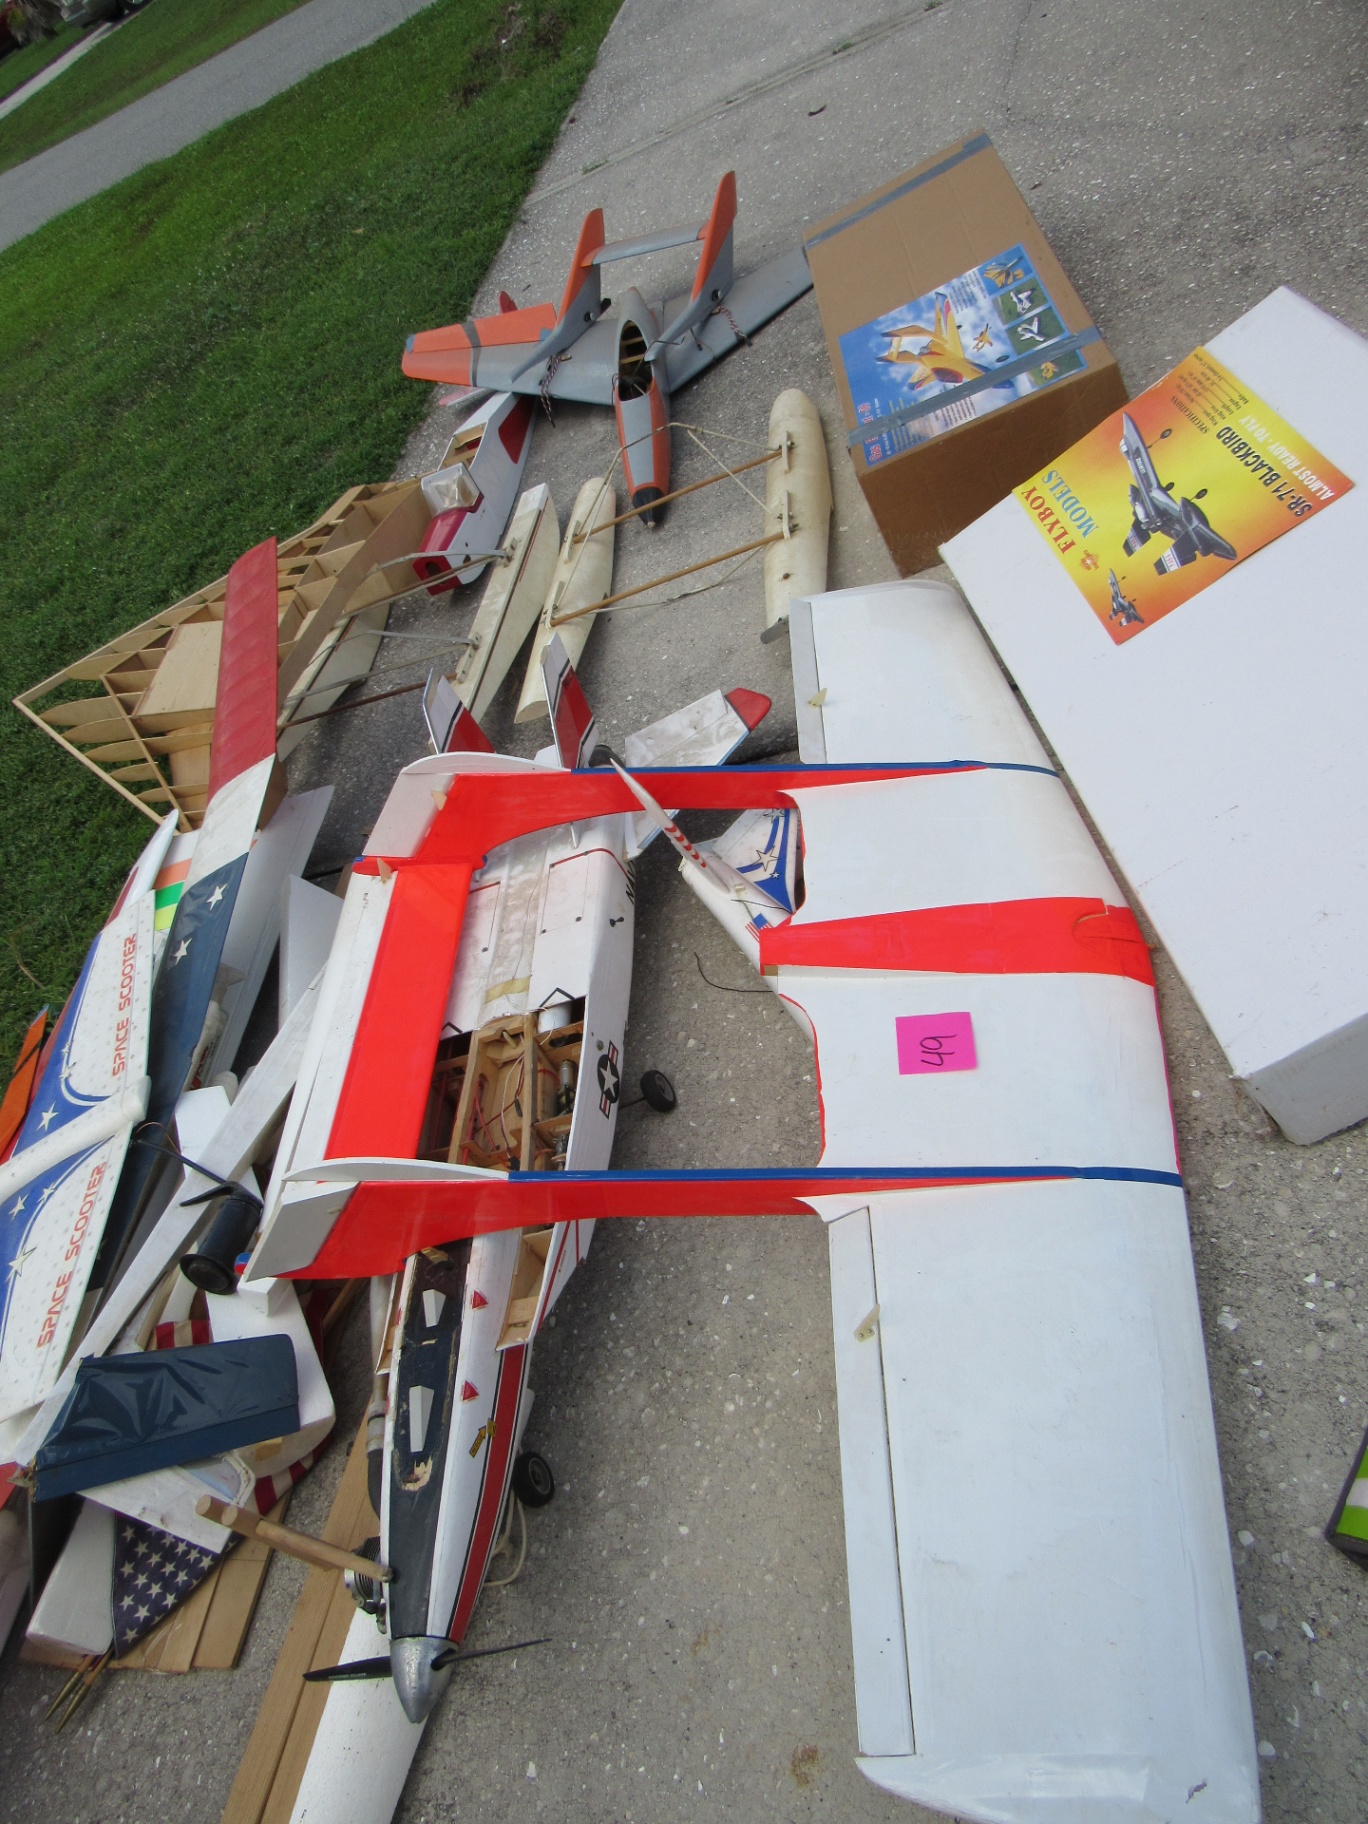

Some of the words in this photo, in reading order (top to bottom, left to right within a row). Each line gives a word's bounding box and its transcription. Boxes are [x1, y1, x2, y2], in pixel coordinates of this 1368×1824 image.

[1239, 415, 1260, 433] FLY
[1253, 427, 1270, 443] TO
[1215, 426, 1282, 487] BLACKBIRD
[1266, 441, 1301, 470] READY
[1041, 469, 1099, 539] MODELS
[1271, 481, 1312, 517] SR-71
[1292, 466, 1335, 501] ALMOST
[1021, 486, 1077, 554] FLYBOY
[118, 932, 137, 1012] SCOOTER
[112, 1016, 129, 1077] SPACE
[919, 1033, 957, 1066] 49
[37, 1270, 73, 1349] SPACE
[64, 1161, 108, 1262] SCOOTER
